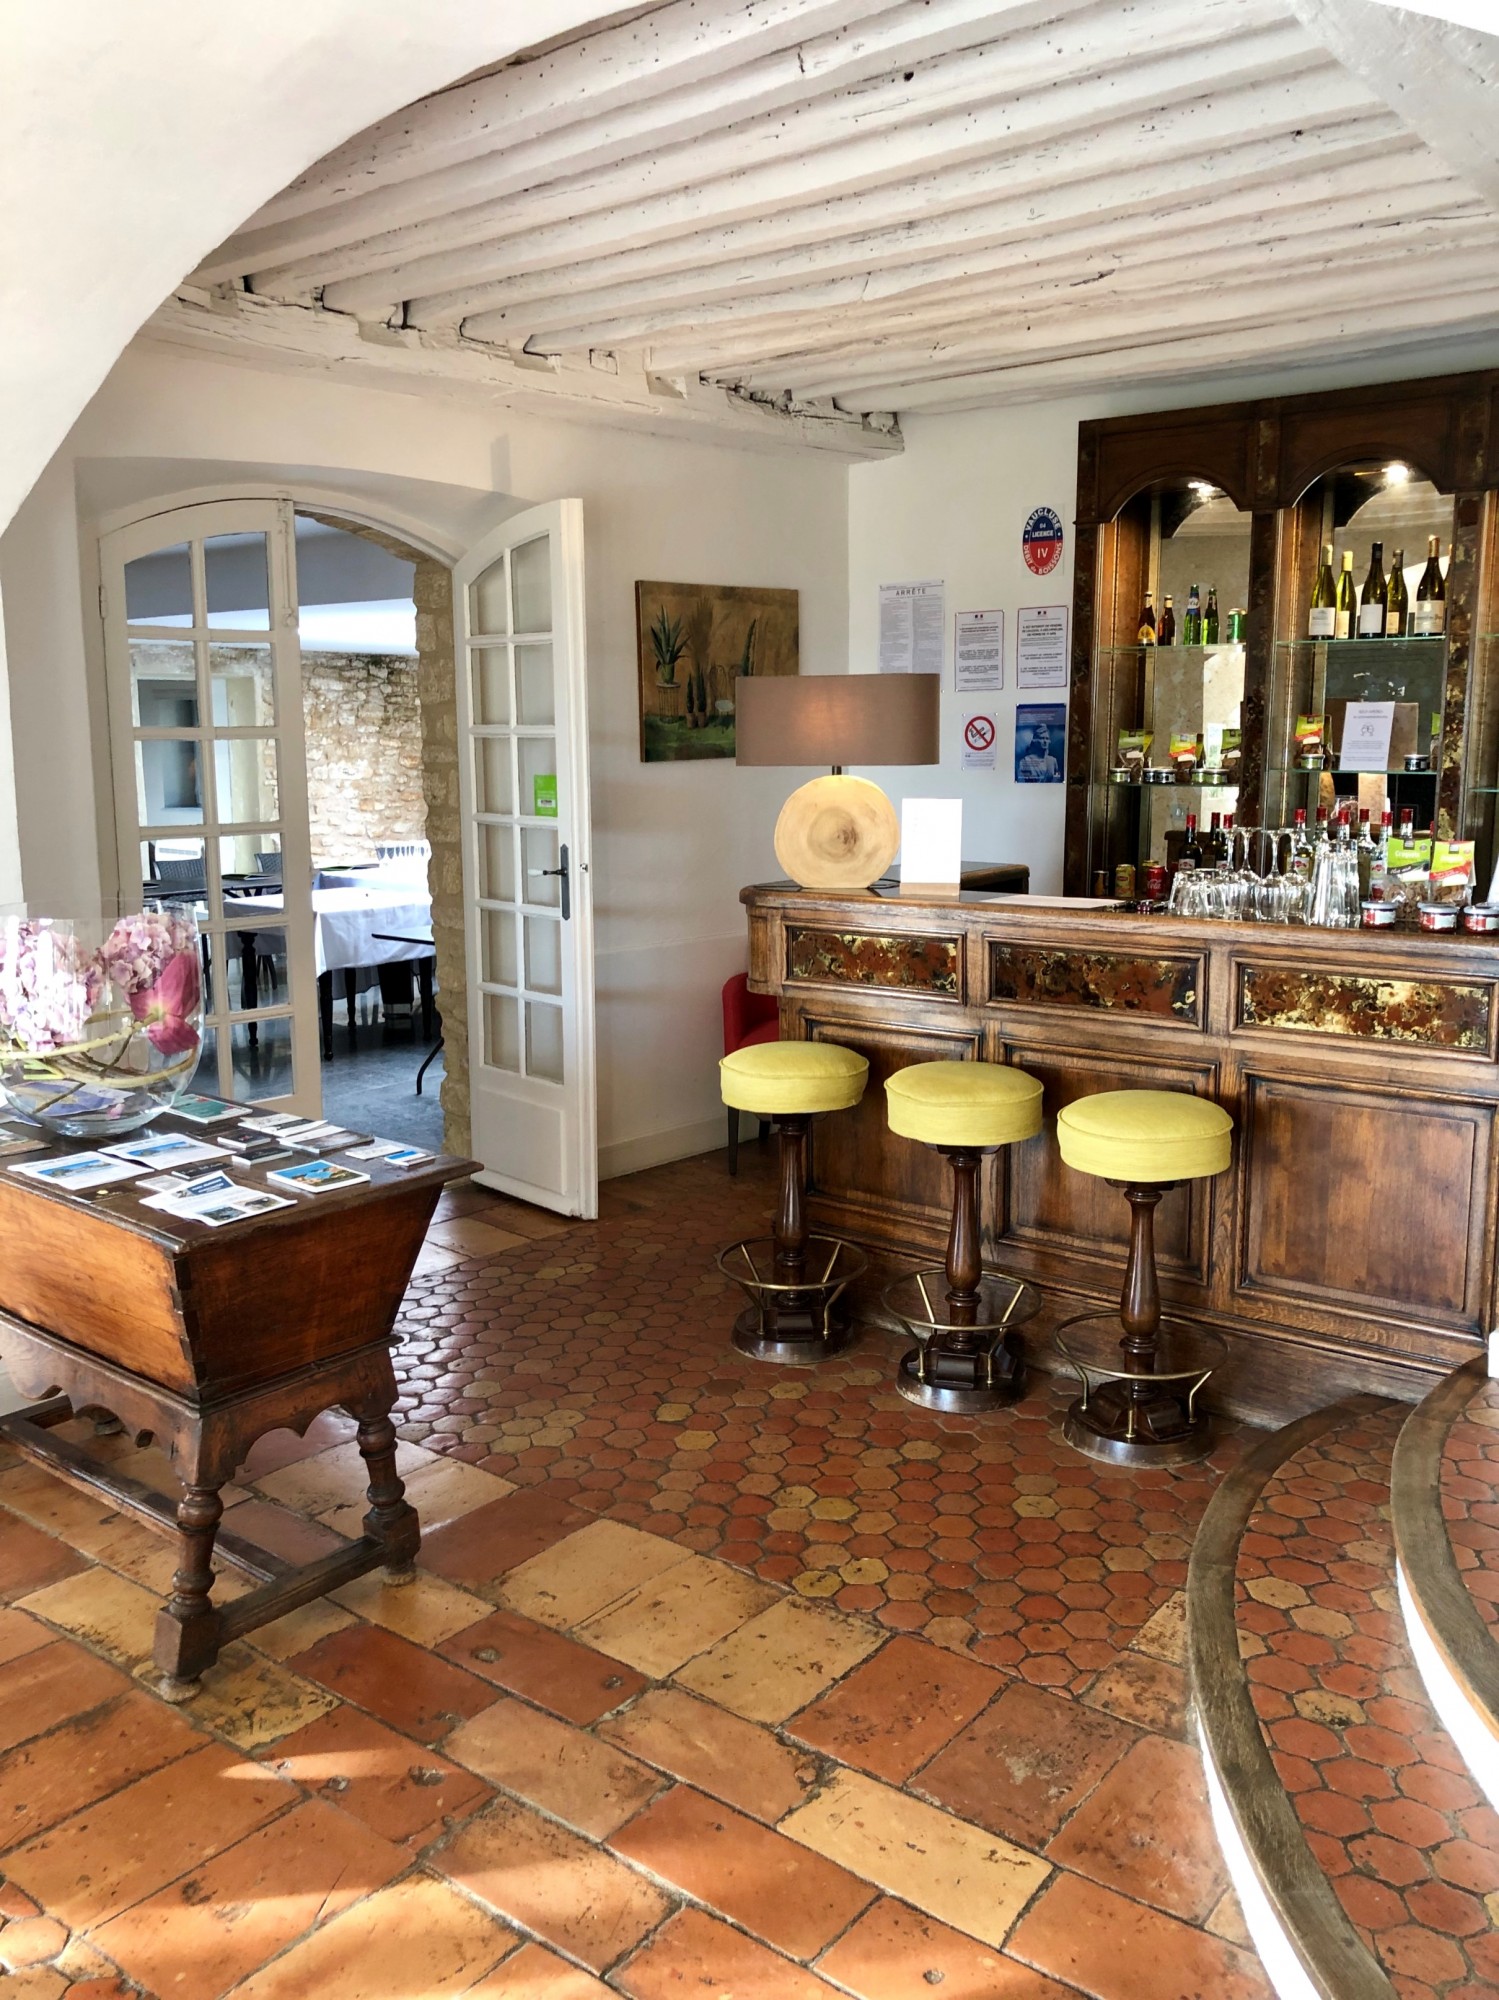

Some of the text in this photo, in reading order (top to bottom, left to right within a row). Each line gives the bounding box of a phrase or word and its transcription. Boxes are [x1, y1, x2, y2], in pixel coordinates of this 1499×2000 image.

[1025, 508, 1061, 531] VAUCLUSE
[1031, 530, 1054, 538] LICENCE
[1037, 547, 1049, 559] IV
[1038, 542, 1062, 575] BOISSONS
